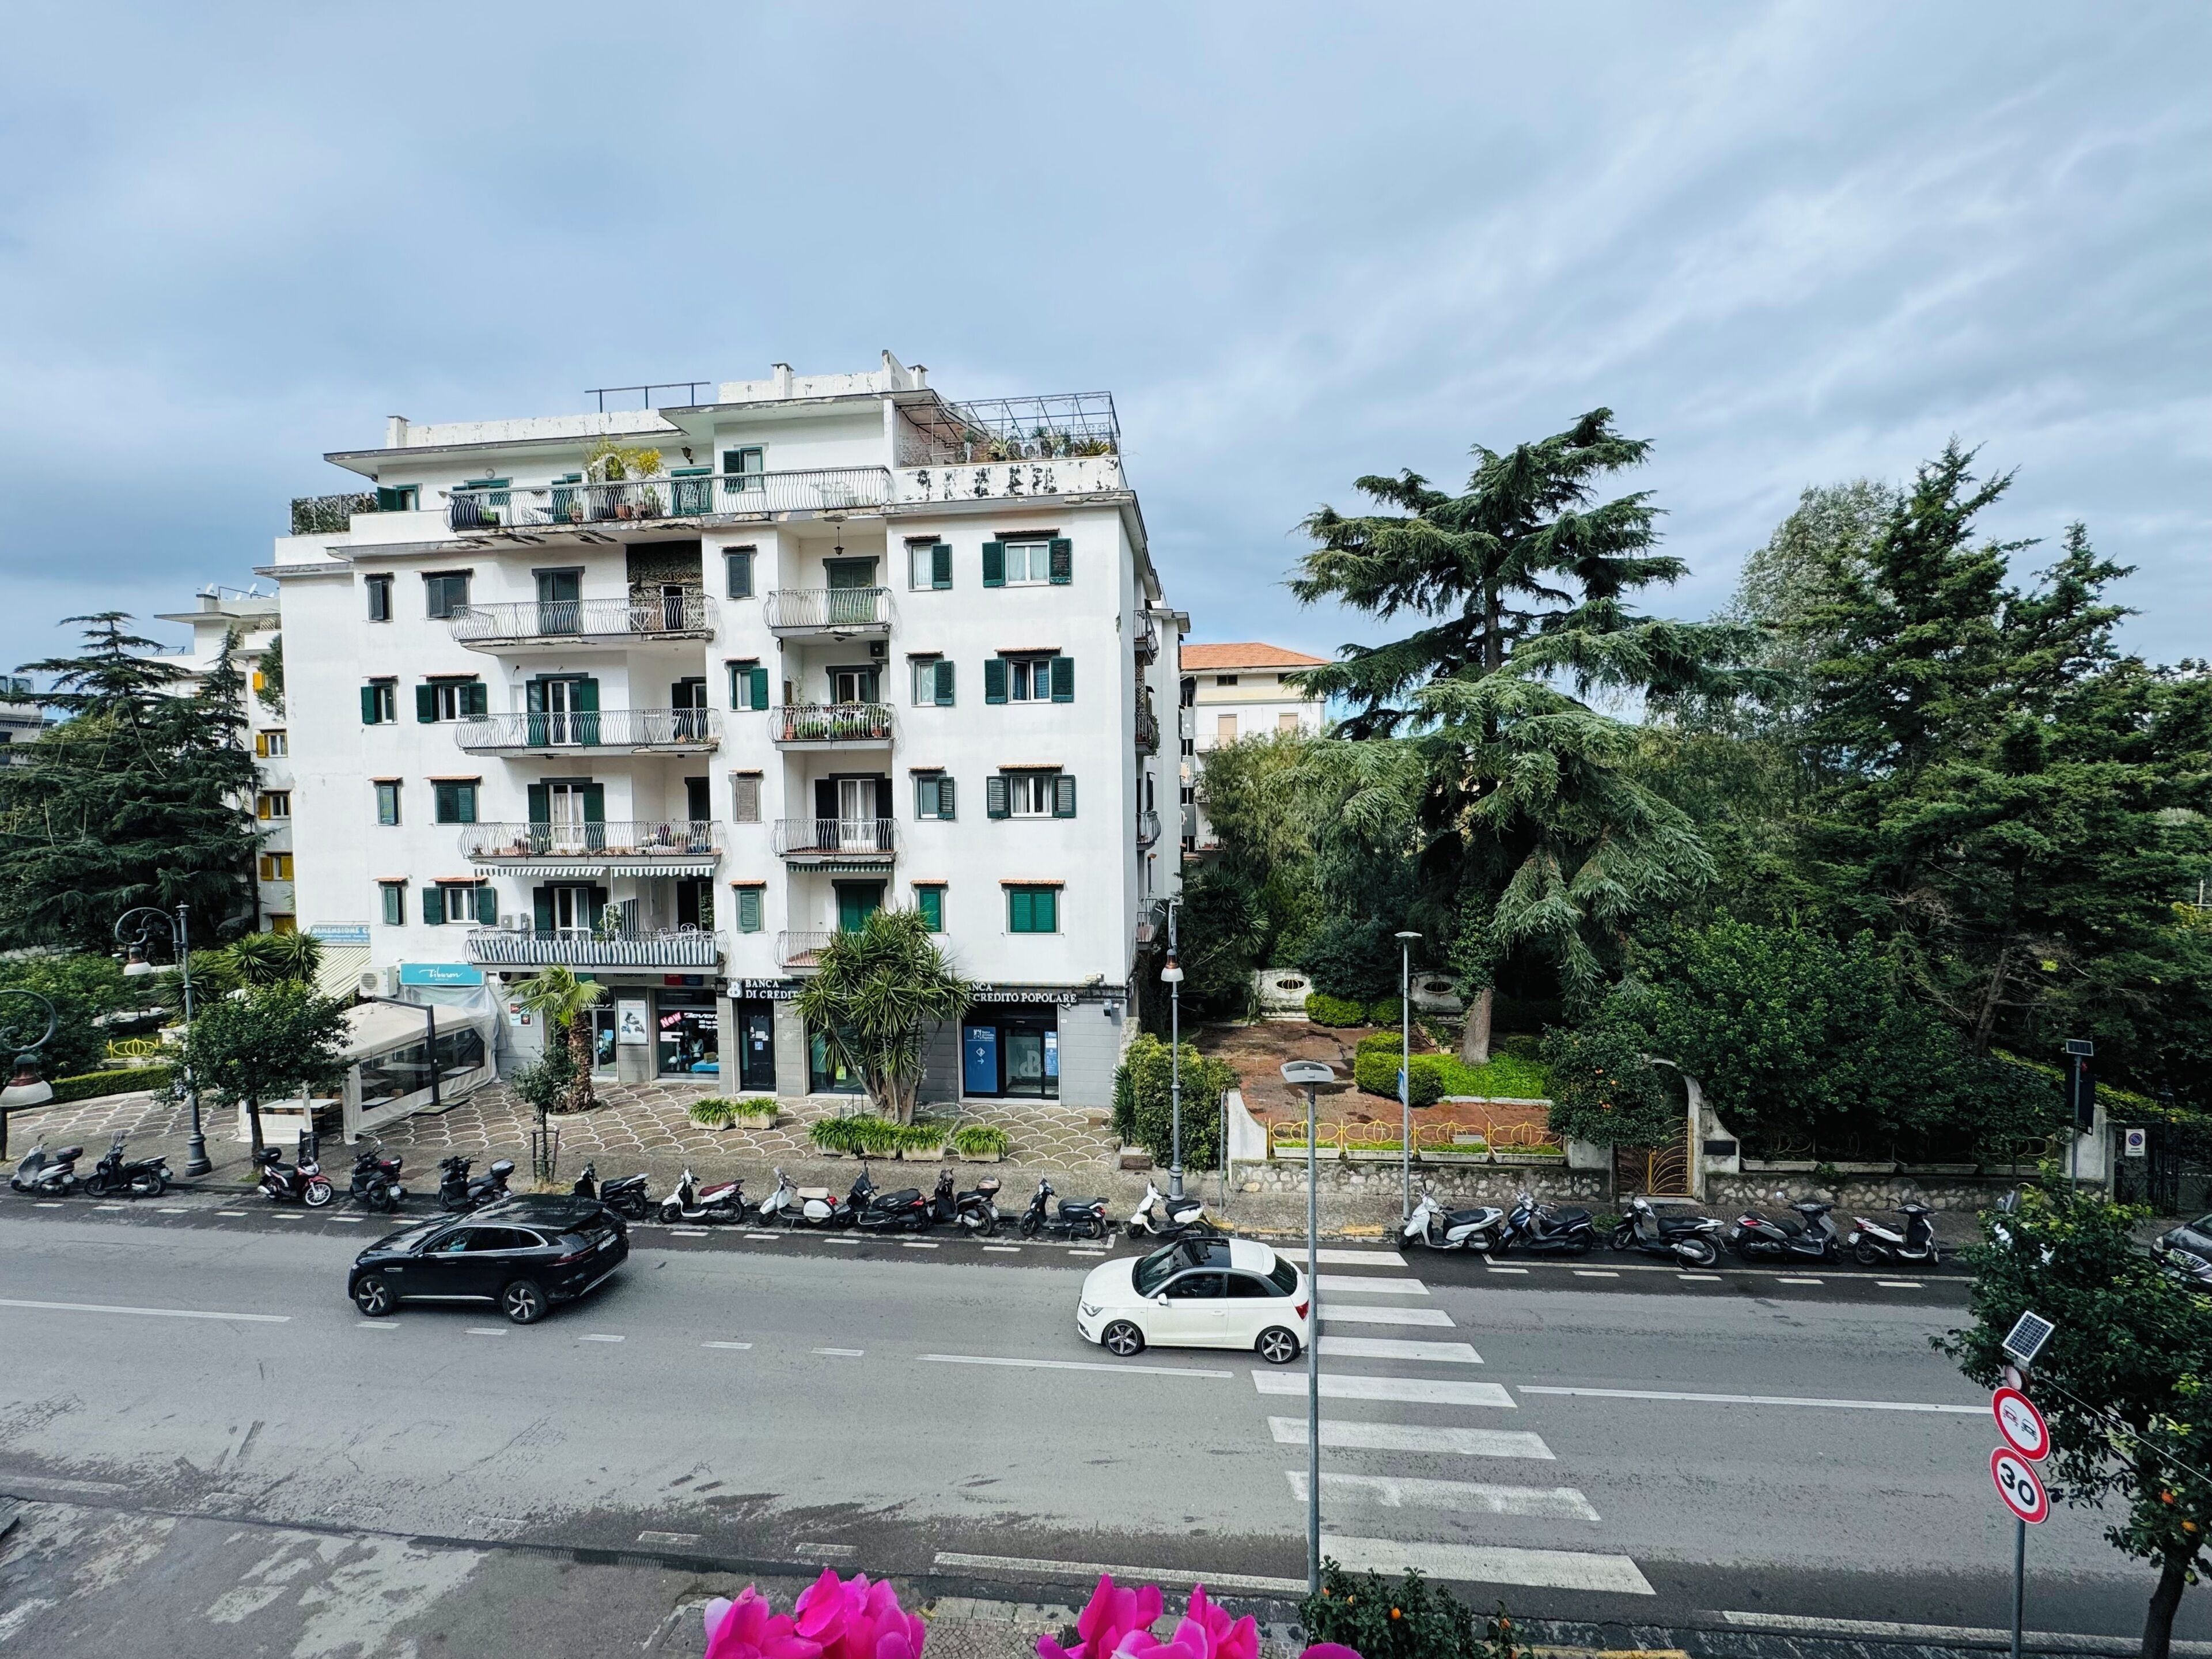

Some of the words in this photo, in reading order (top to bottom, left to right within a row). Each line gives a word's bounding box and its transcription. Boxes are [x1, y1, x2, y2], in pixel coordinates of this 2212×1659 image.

[745, 979, 780, 988] BANCA
[966, 982, 993, 991] ANCA
[745, 990, 757, 999] DI
[759, 990, 804, 999] CREDIT
[973, 993, 1019, 1002] CREDITO
[1021, 993, 1077, 1003] POPOLARE
[660, 1011, 681, 1029] New
[2000, 1463, 2035, 1506] 30
